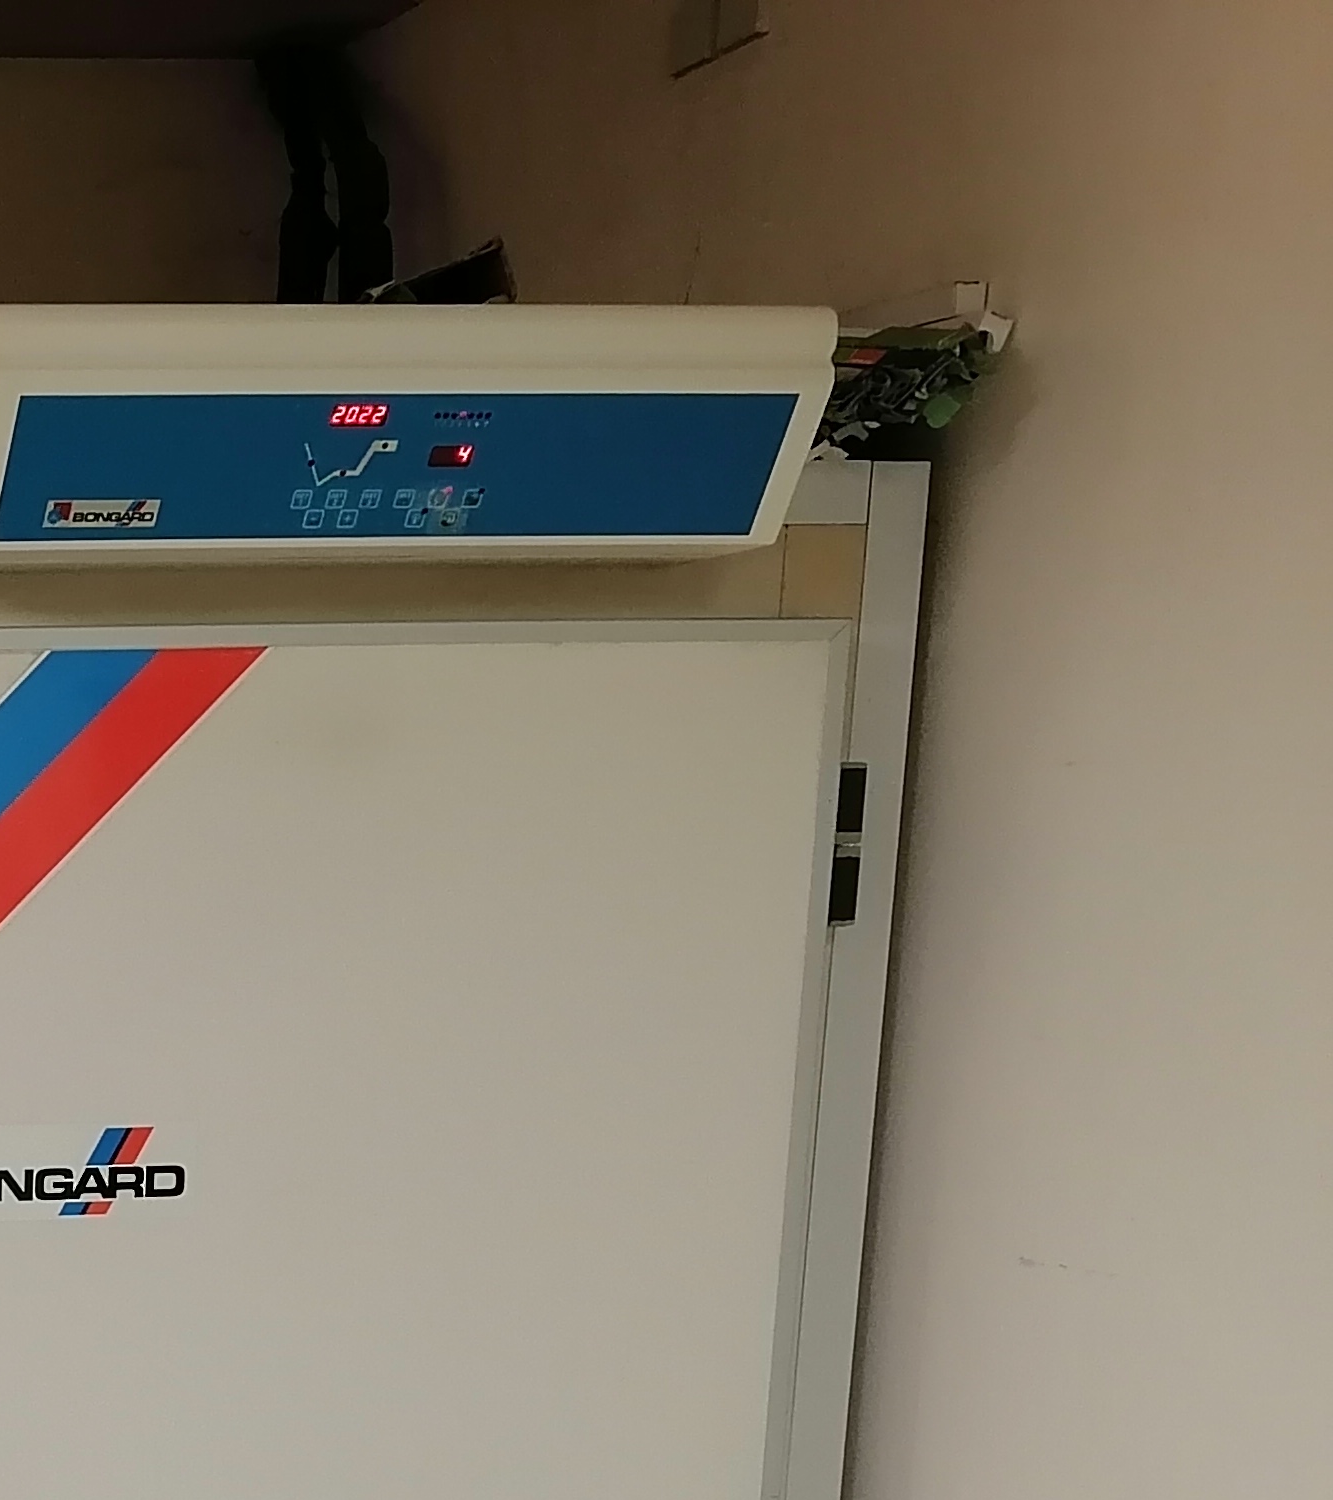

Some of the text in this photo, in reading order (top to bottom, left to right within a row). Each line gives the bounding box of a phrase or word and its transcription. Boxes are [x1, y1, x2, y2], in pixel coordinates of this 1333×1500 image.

[331, 405, 387, 424] 2022
[457, 445, 473, 463] 4
[72, 511, 155, 523] BONGARD
